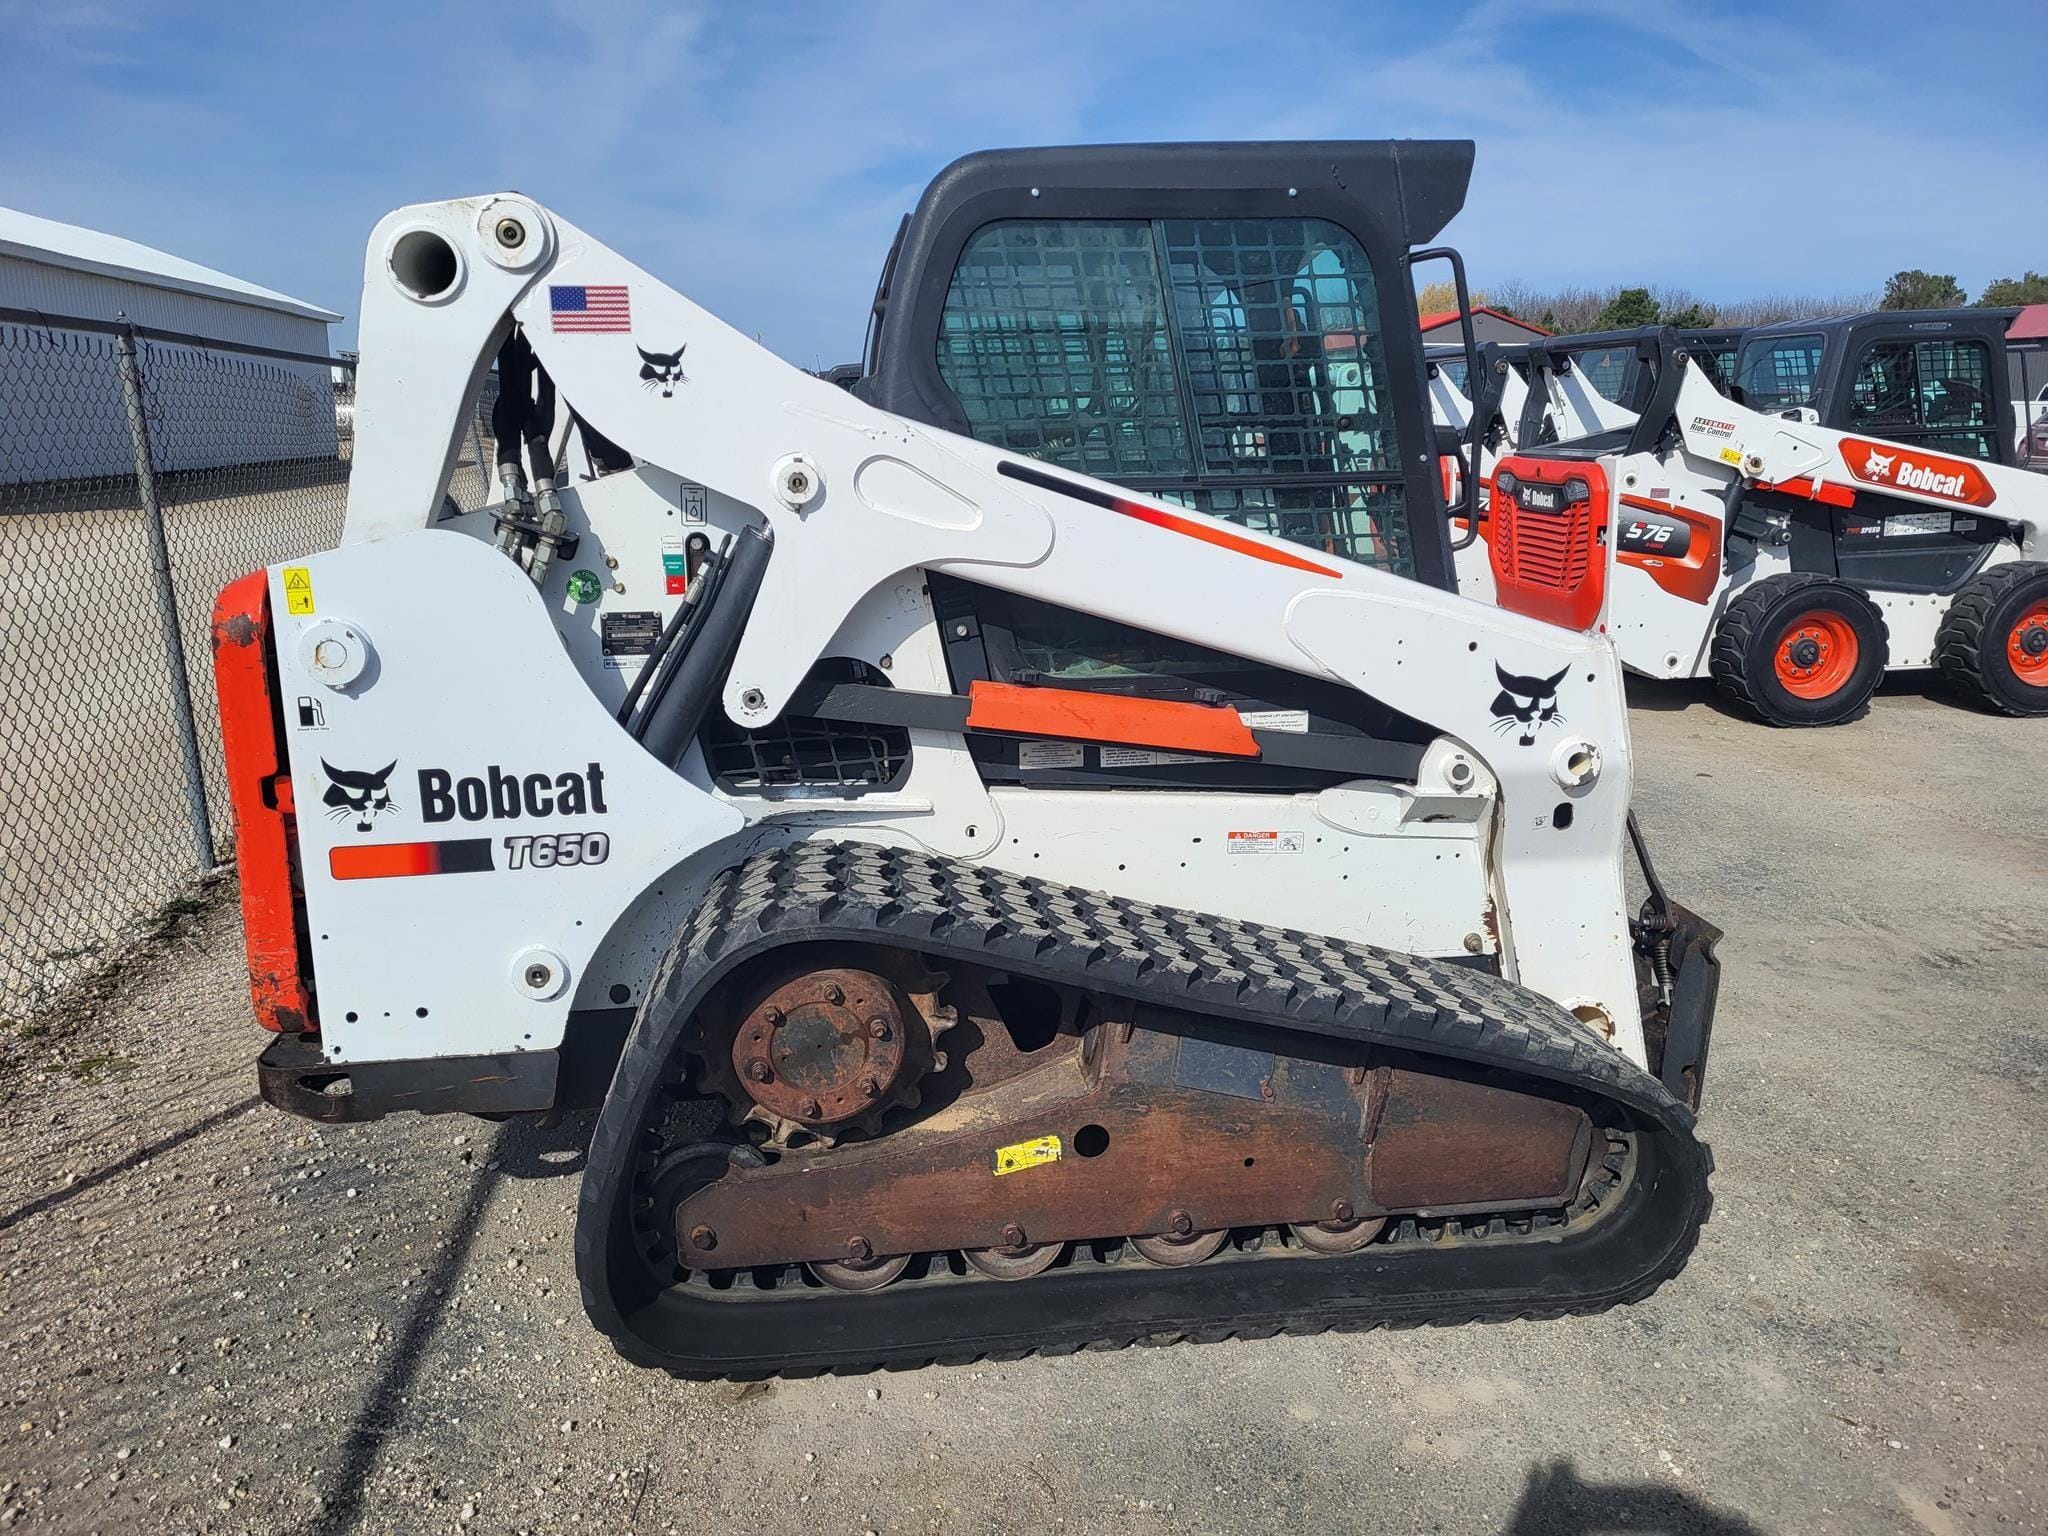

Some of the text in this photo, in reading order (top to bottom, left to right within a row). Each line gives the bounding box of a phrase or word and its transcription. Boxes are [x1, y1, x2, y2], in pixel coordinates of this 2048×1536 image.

[1689, 423, 1733, 439] Ride Control
[1693, 416, 1736, 431] AUTOMATIC
[1896, 461, 1966, 498] Bobcat
[1532, 490, 1554, 508] Bobcat
[1625, 521, 1675, 543] S76
[1860, 526, 1881, 534] SPEED
[417, 762, 608, 823] Bobcat
[503, 832, 610, 870] T650
